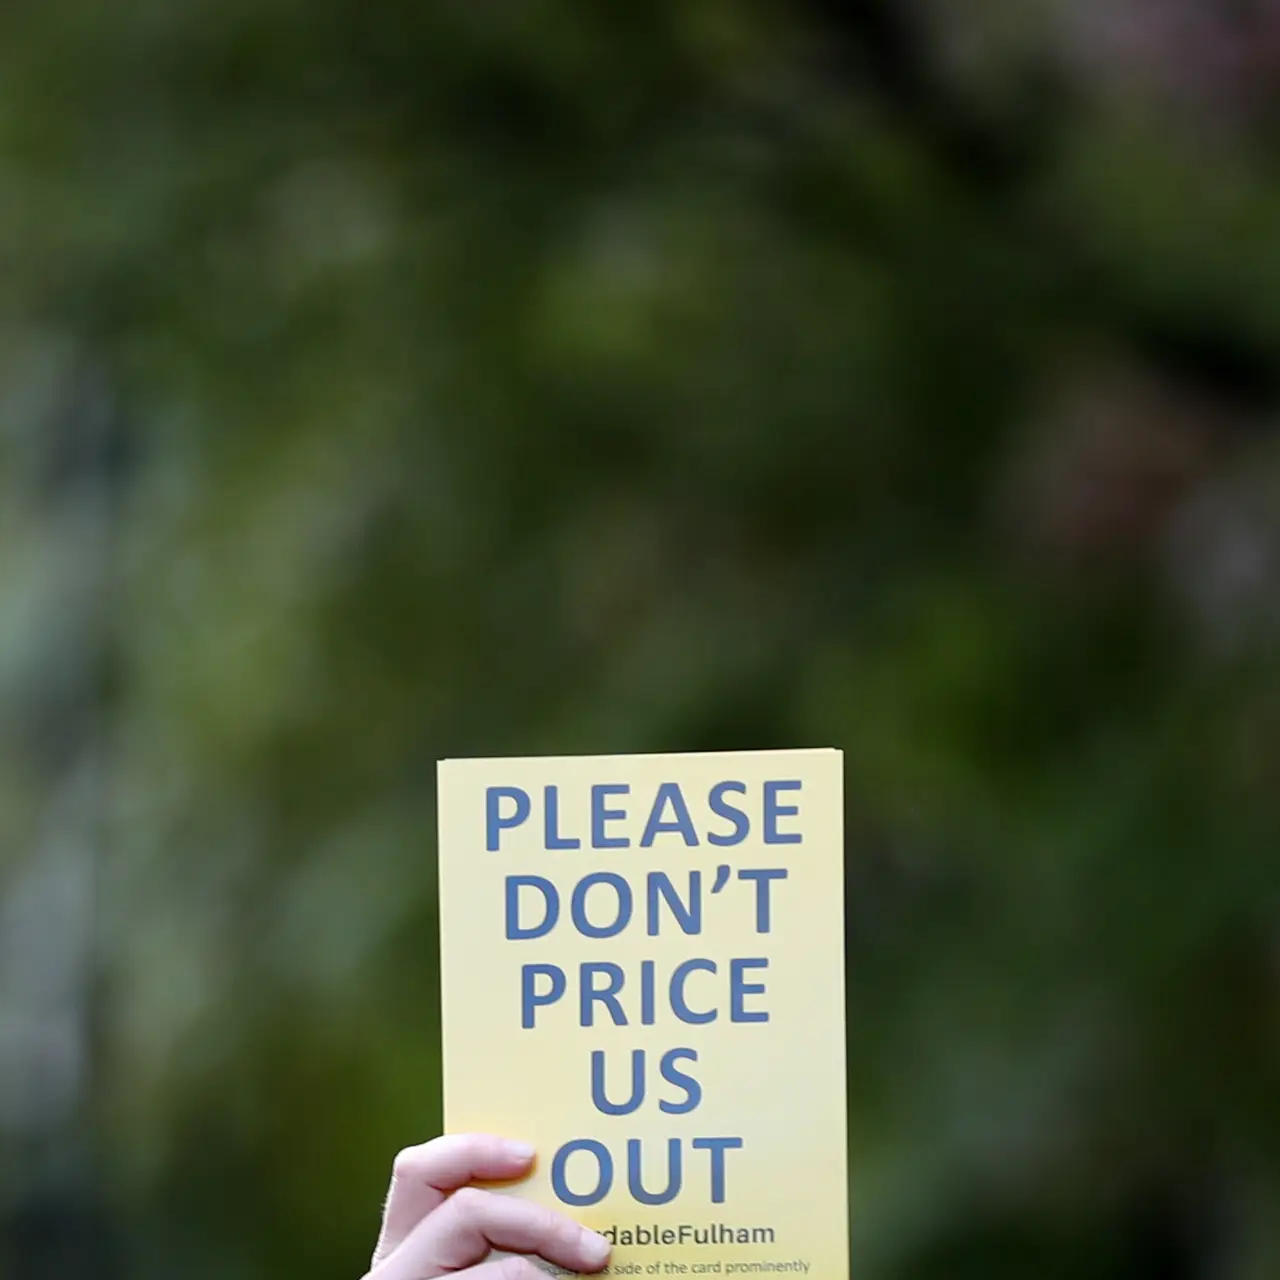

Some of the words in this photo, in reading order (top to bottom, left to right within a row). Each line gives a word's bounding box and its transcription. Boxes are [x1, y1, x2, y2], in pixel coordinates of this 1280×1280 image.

[484, 779, 804, 852] PLEASE
[504, 864, 789, 940] DON'T
[520, 956, 771, 1029] PRICE
[589, 1046, 703, 1116] US
[550, 1136, 744, 1207] OUT
[595, 1223, 776, 1246] dableFulham
[614, 1261, 642, 1276] side
[646, 1260, 663, 1275] of
[664, 1260, 689, 1275] the
[690, 1259, 722, 1275] card
[725, 1258, 811, 1277] prominently
